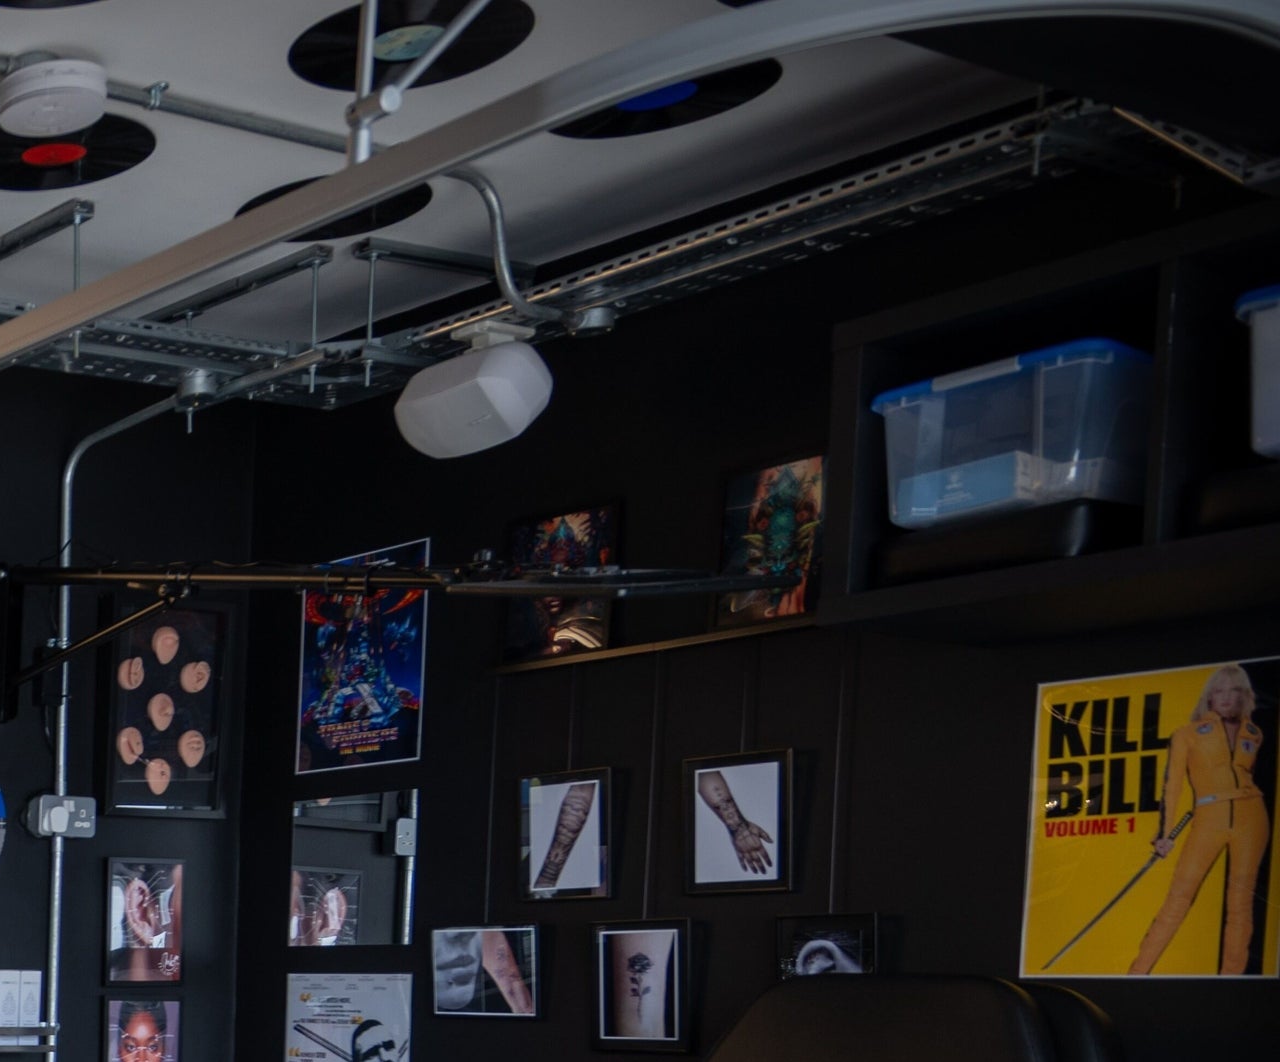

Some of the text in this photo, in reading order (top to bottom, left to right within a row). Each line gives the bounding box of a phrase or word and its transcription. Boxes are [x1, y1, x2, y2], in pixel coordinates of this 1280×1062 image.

[1050, 693, 1171, 758] KILL
[1046, 756, 1161, 818] BILL
[1046, 816, 1136, 837] VOLUME 1
